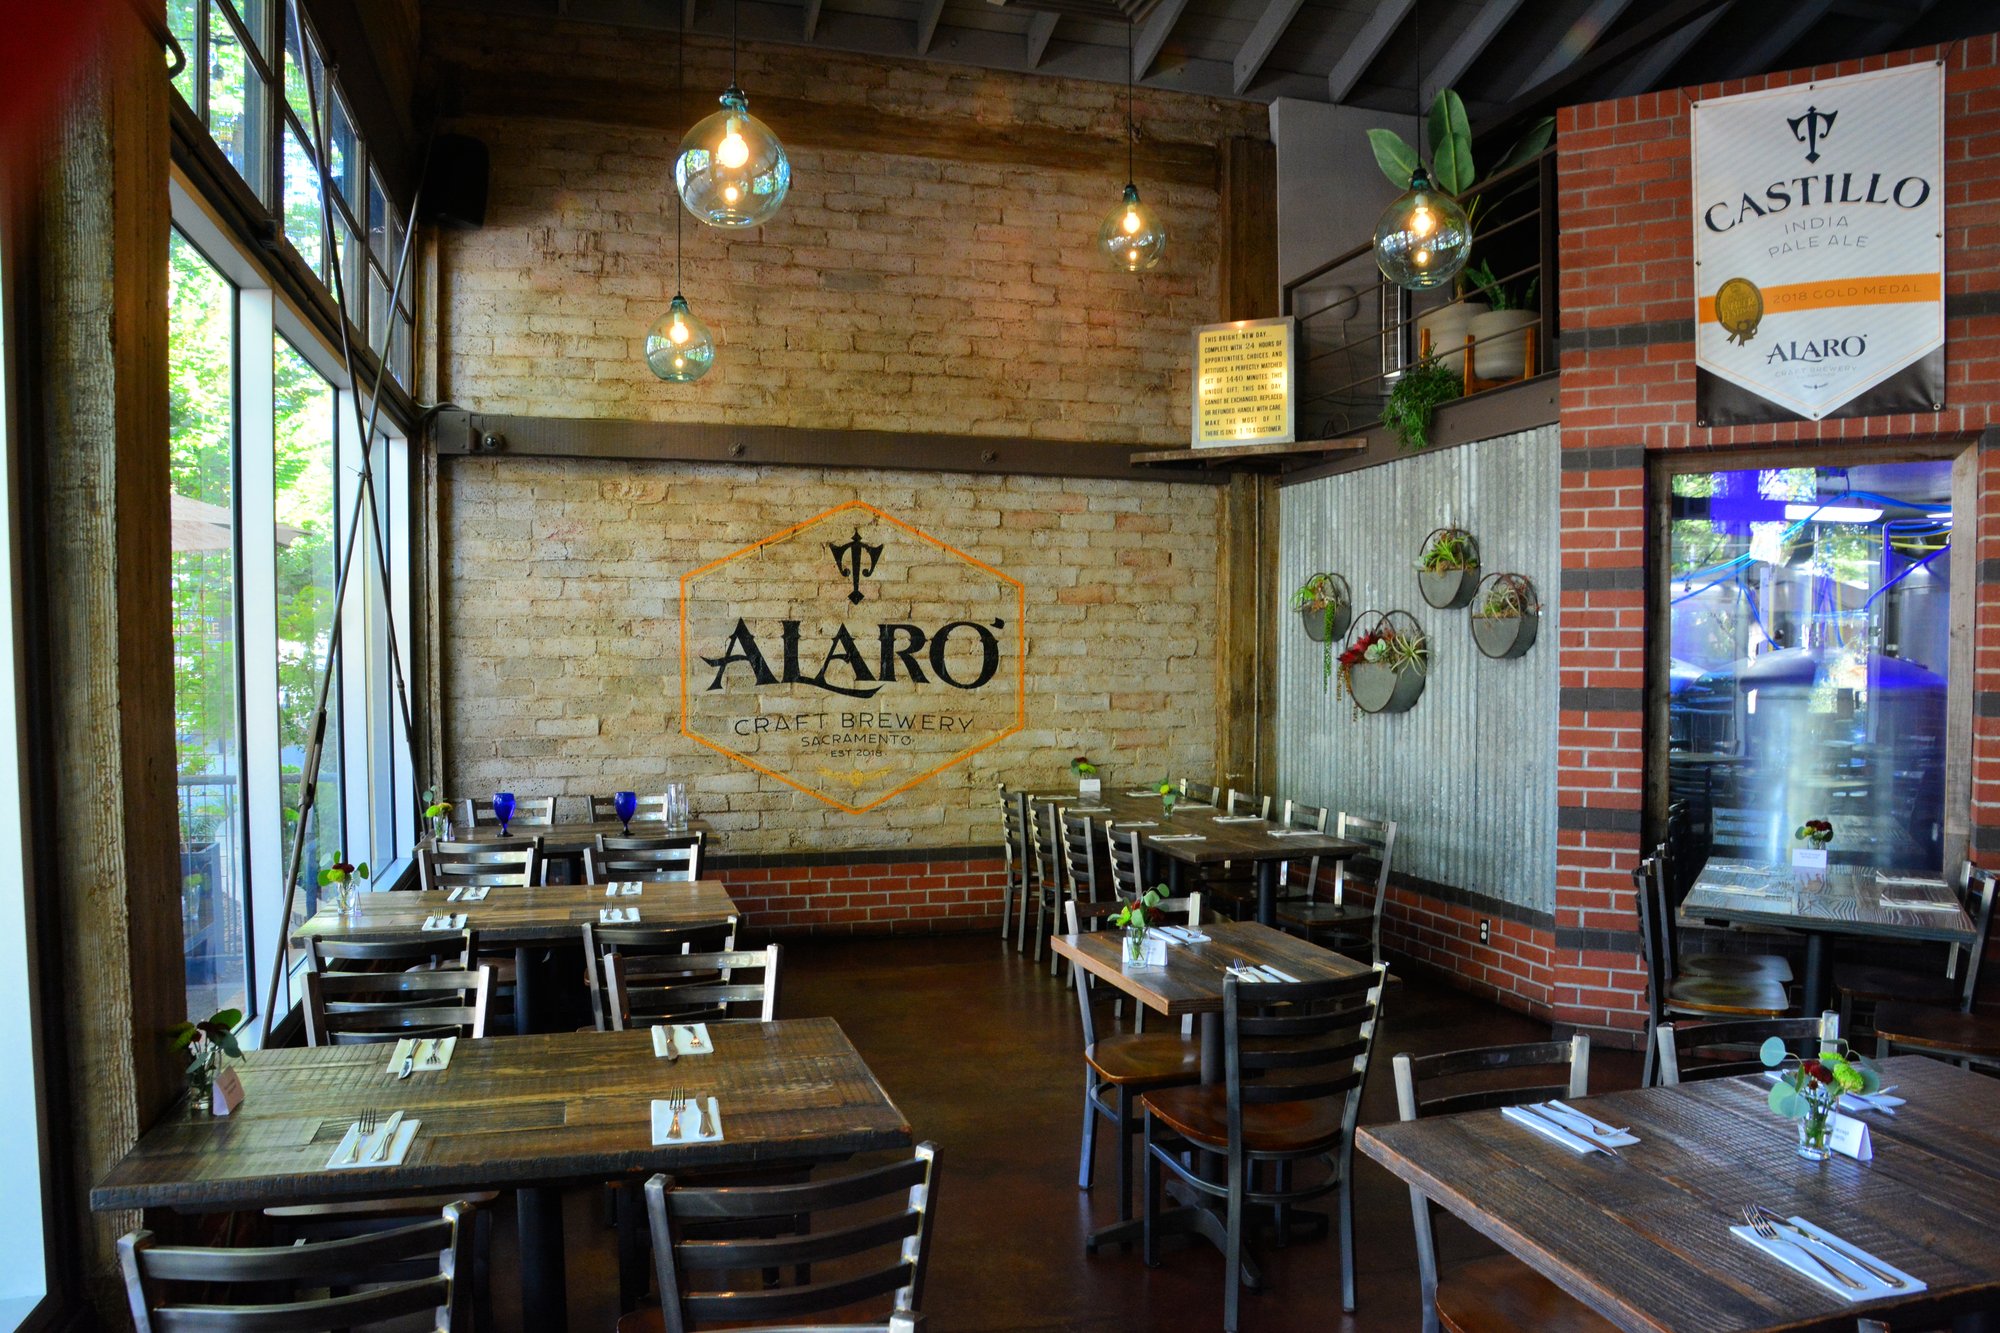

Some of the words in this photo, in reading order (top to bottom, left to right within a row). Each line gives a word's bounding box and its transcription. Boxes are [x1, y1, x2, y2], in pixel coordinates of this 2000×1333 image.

[1704, 172, 1931, 233] CASTILLO
[1784, 215, 1849, 235] INDIA
[1768, 235, 1820, 258] PALE
[1827, 235, 1869, 248] ALE
[1773, 292, 1808, 304] 2018
[1812, 287, 1858, 300] GOLD
[1863, 283, 1921, 296] MEDAL
[734, 712, 830, 736] CRAFT
[841, 712, 974, 733] BREWERY
[801, 733, 912, 747] SACRAMENTO
[831, 750, 852, 758] EST
[856, 750, 883, 758] 2018
